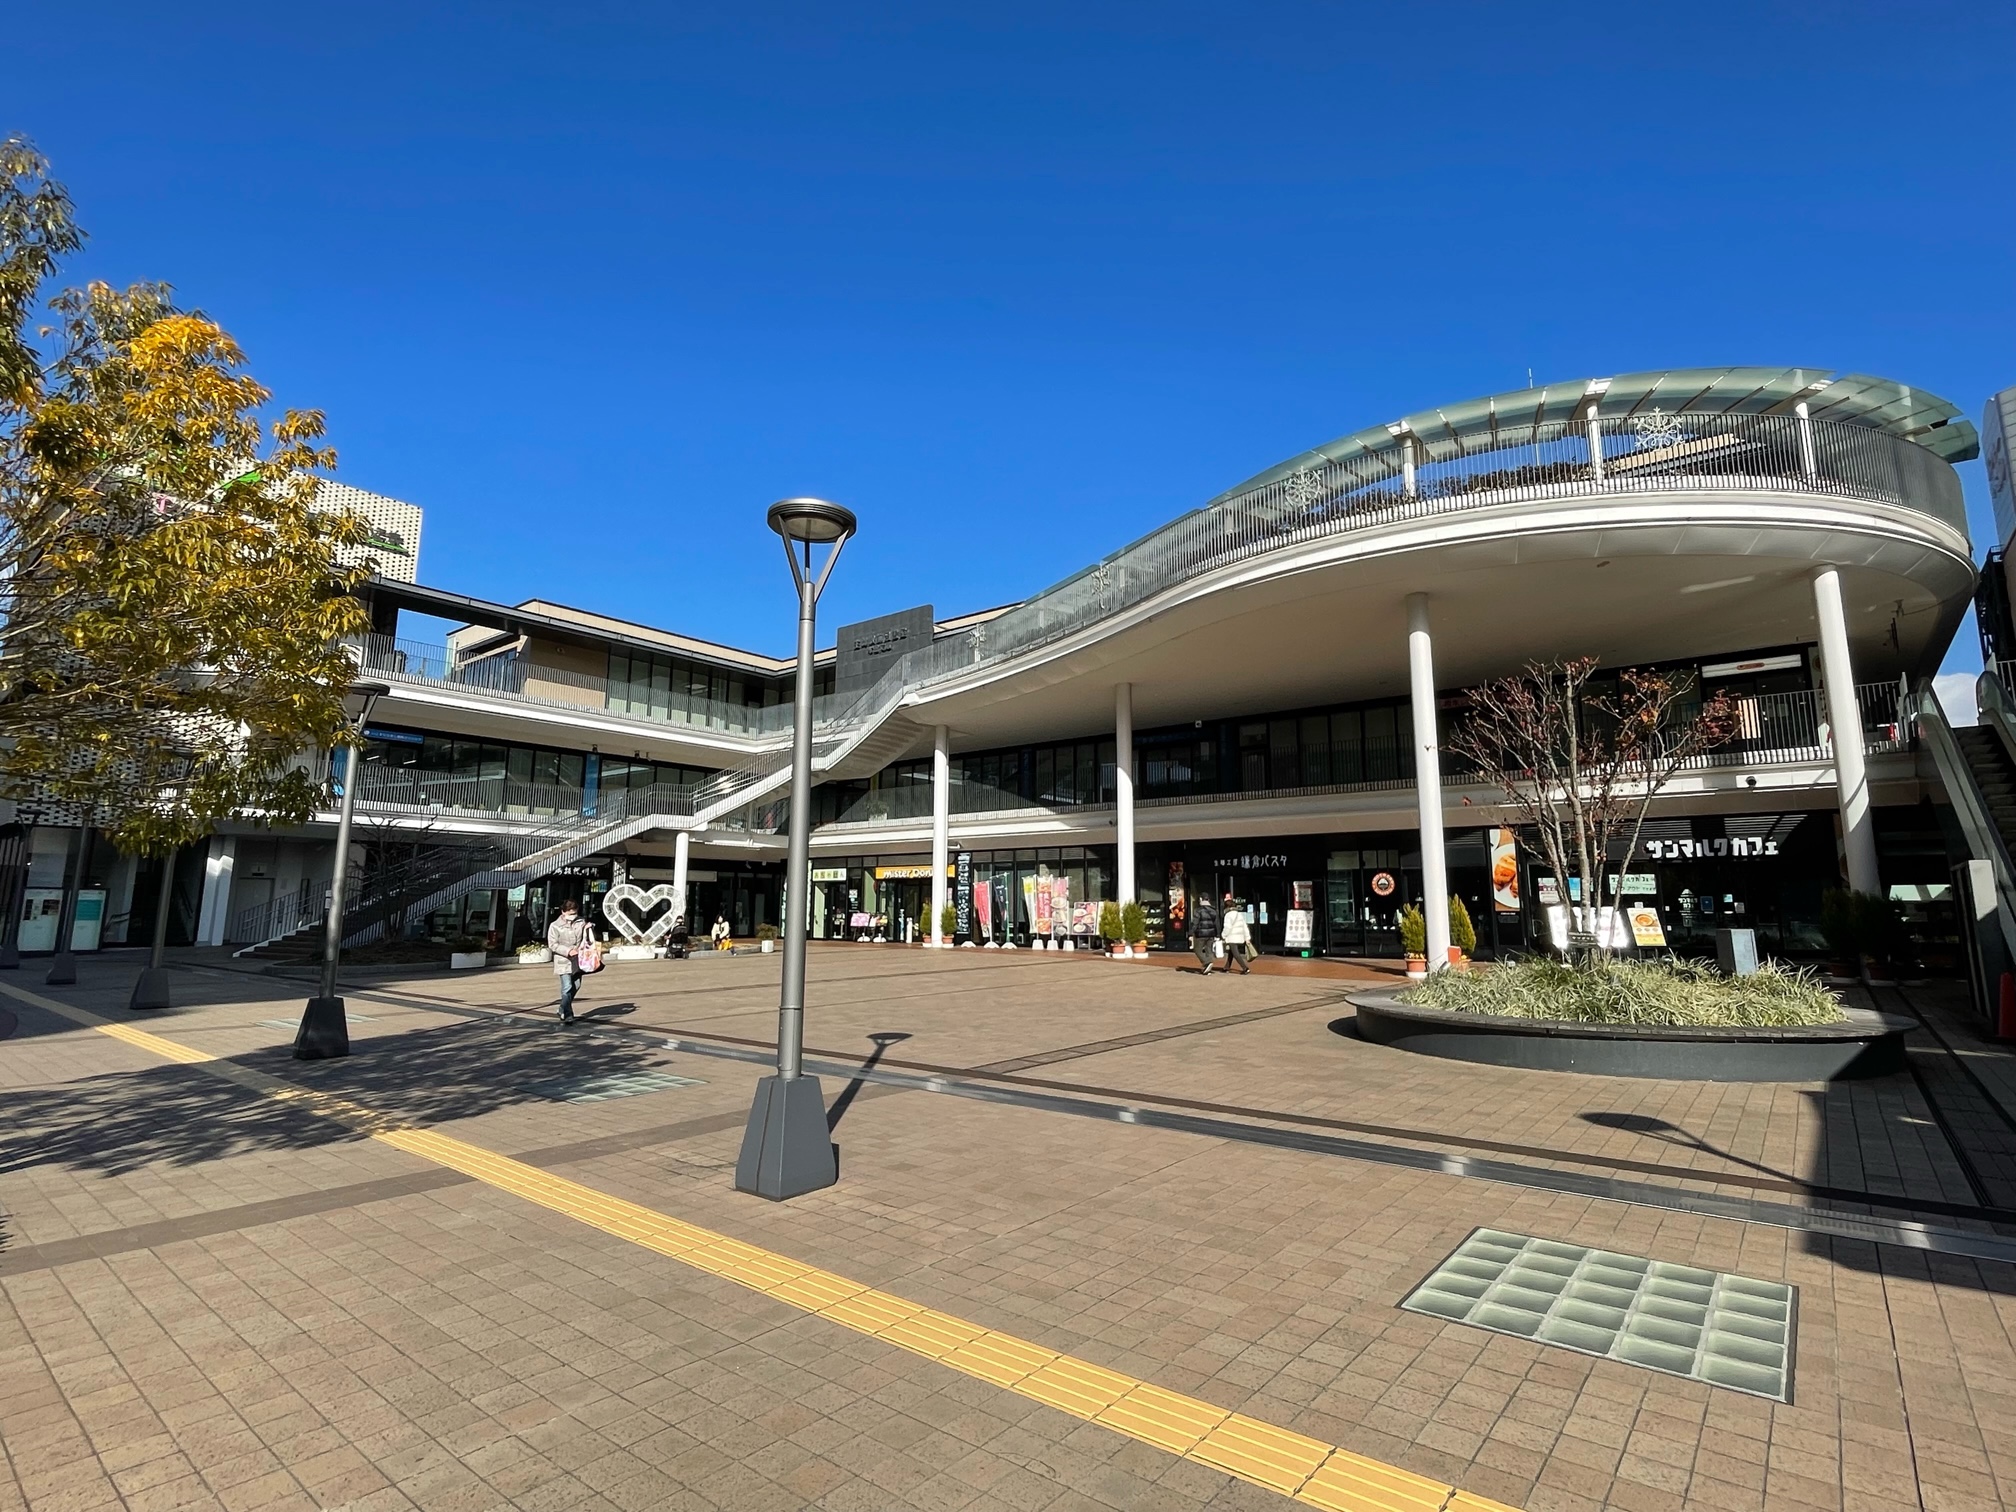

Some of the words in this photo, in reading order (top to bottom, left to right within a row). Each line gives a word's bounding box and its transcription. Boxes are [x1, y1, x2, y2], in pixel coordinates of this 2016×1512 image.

[1646, 836, 1779, 858] サンマルクカフェ
